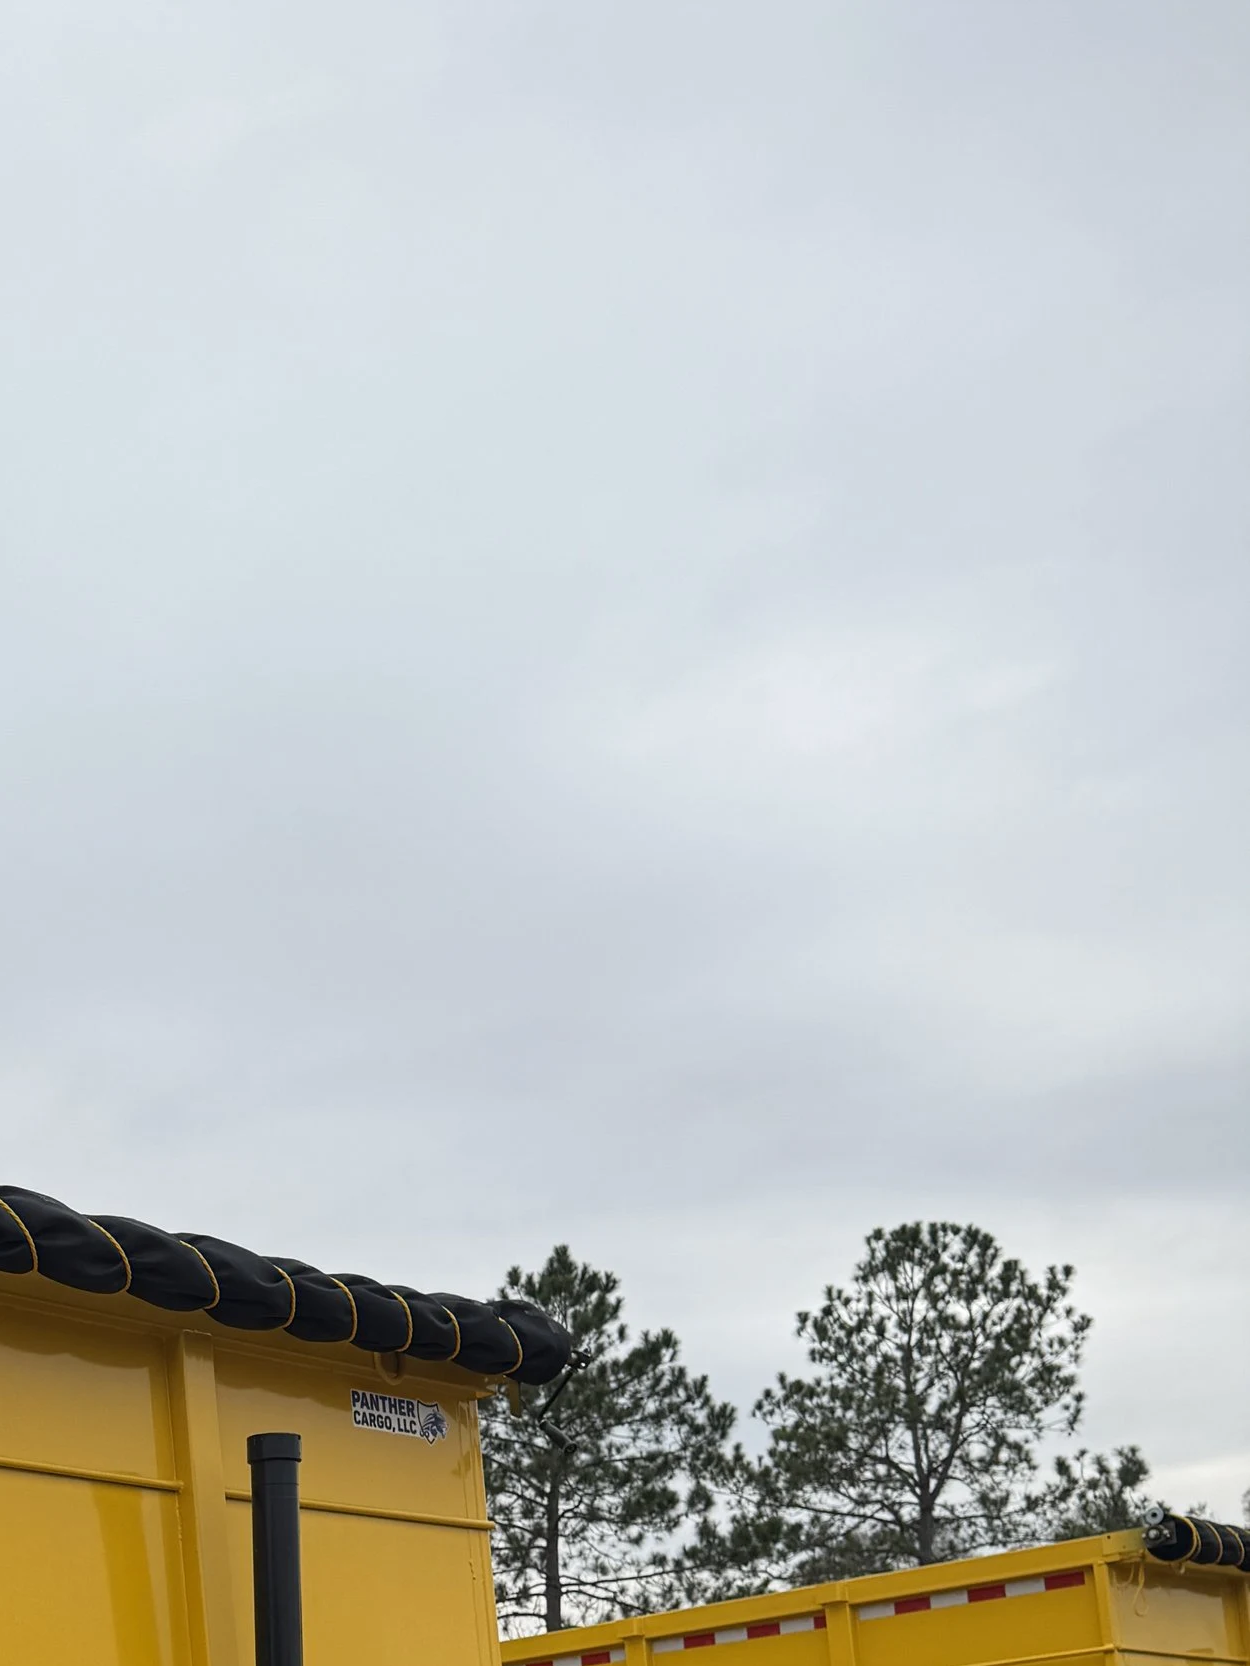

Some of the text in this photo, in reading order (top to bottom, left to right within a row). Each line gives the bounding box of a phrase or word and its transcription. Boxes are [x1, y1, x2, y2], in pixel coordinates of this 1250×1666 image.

[351, 1390, 416, 1418] PANTHER
[353, 1410, 418, 1435] CARGO, LLC
